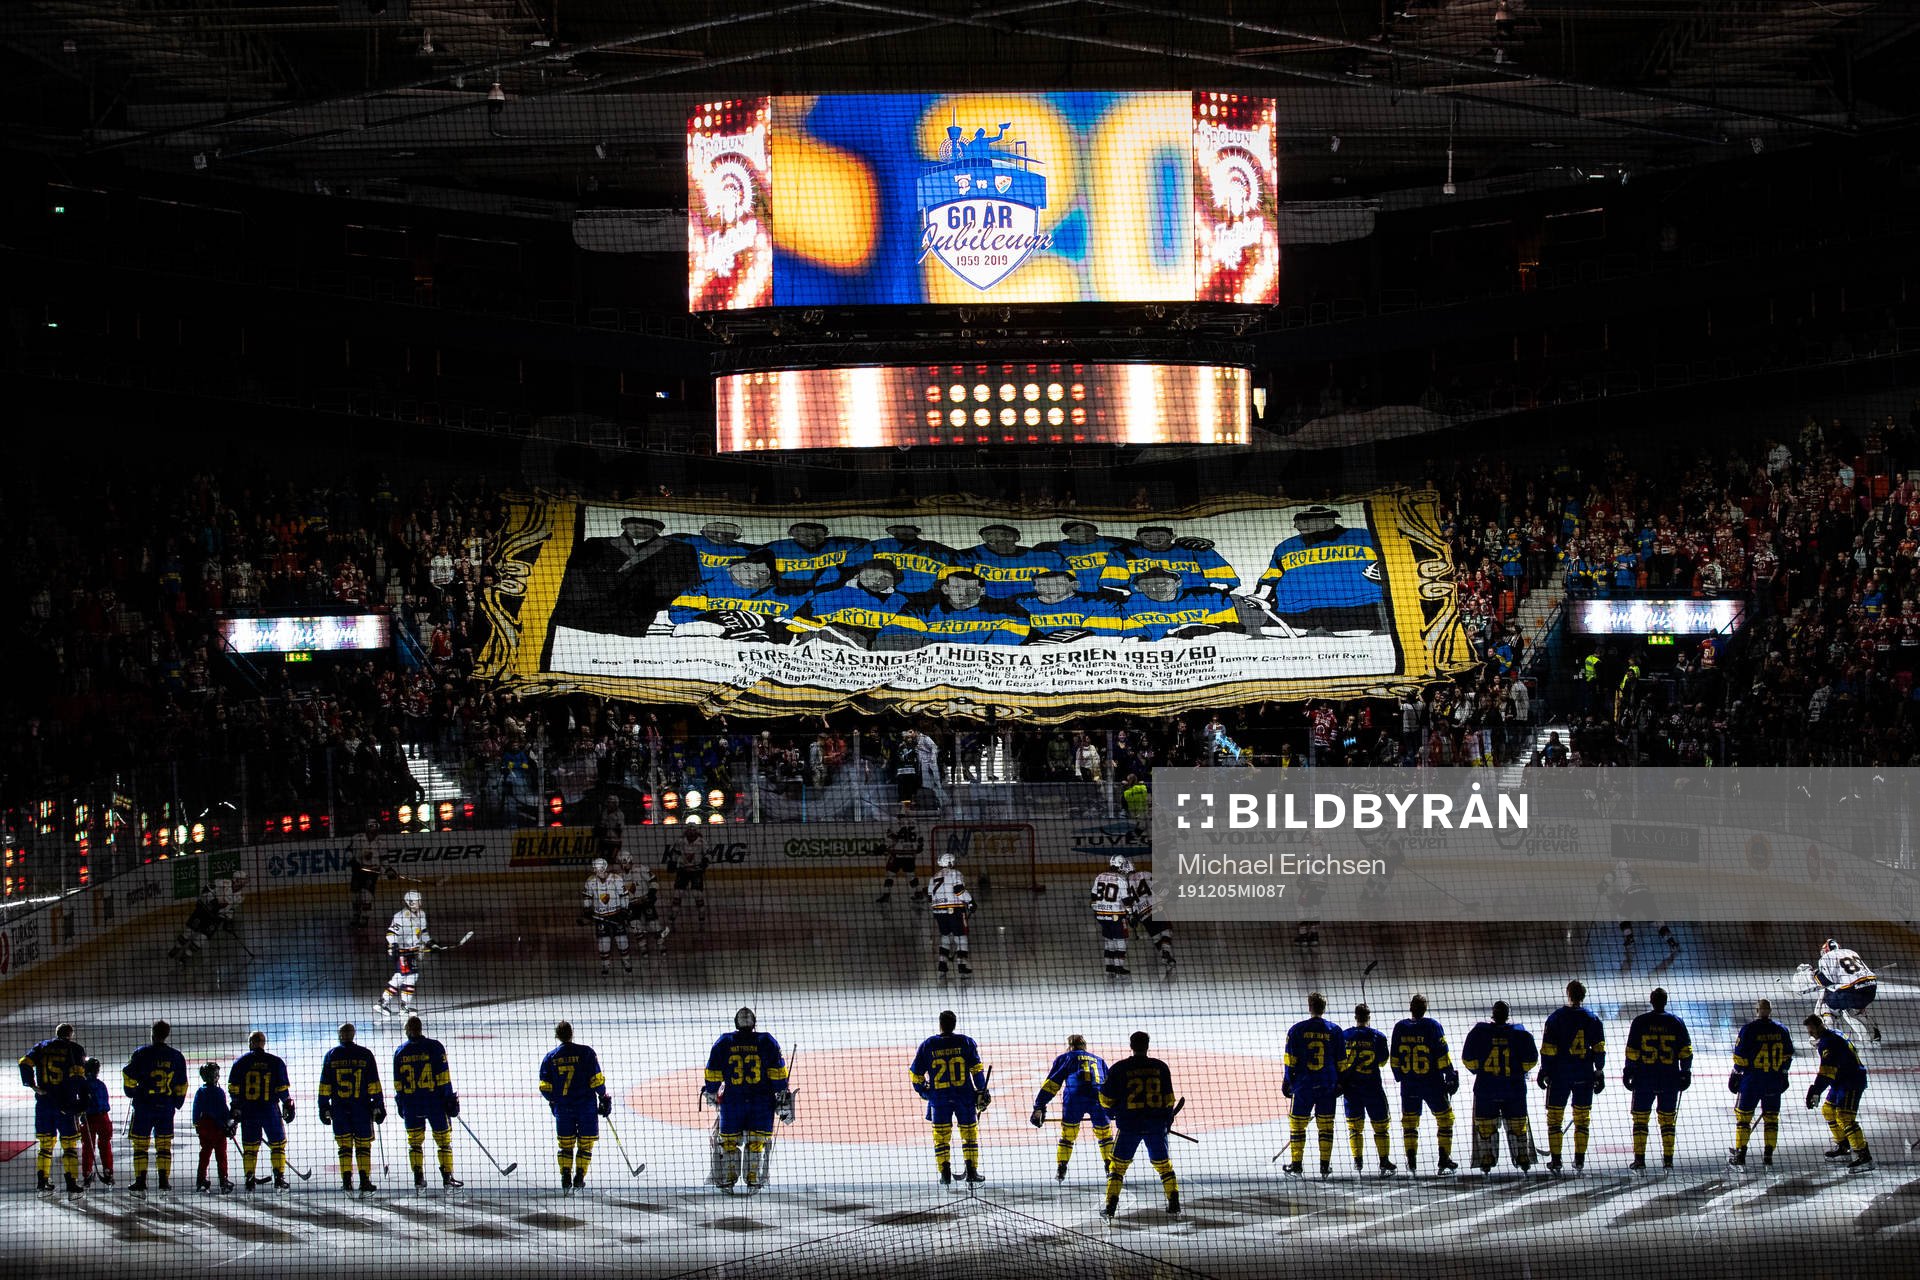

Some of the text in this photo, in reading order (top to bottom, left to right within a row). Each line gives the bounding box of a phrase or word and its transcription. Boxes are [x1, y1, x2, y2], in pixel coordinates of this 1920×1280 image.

[947, 202, 1013, 229] 60 ÅR
[917, 222, 1054, 264] Jubileum
[956, 255, 1008, 266] 1959 2019
[738, 645, 814, 664] FÖRSA
[1041, 648, 1117, 665] SERIEN
[1124, 645, 1217, 664] 1959/60
[1536, 823, 1580, 840] Kaffe
[1525, 838, 1580, 857] greven
[933, 876, 945, 896] 7
[1306, 1040, 1325, 1071] 3
[1568, 1028, 1587, 1060] 4
[1640, 1034, 1677, 1065] 55
[1752, 1042, 1786, 1073] 40
[727, 1054, 762, 1085] 33
[930, 1056, 966, 1089] 20
[1483, 1046, 1512, 1077] 41
[245, 1071, 272, 1103] 81
[334, 1068, 363, 1099] 51
[400, 1063, 435, 1094] 34
[557, 1065, 576, 1096] 7
